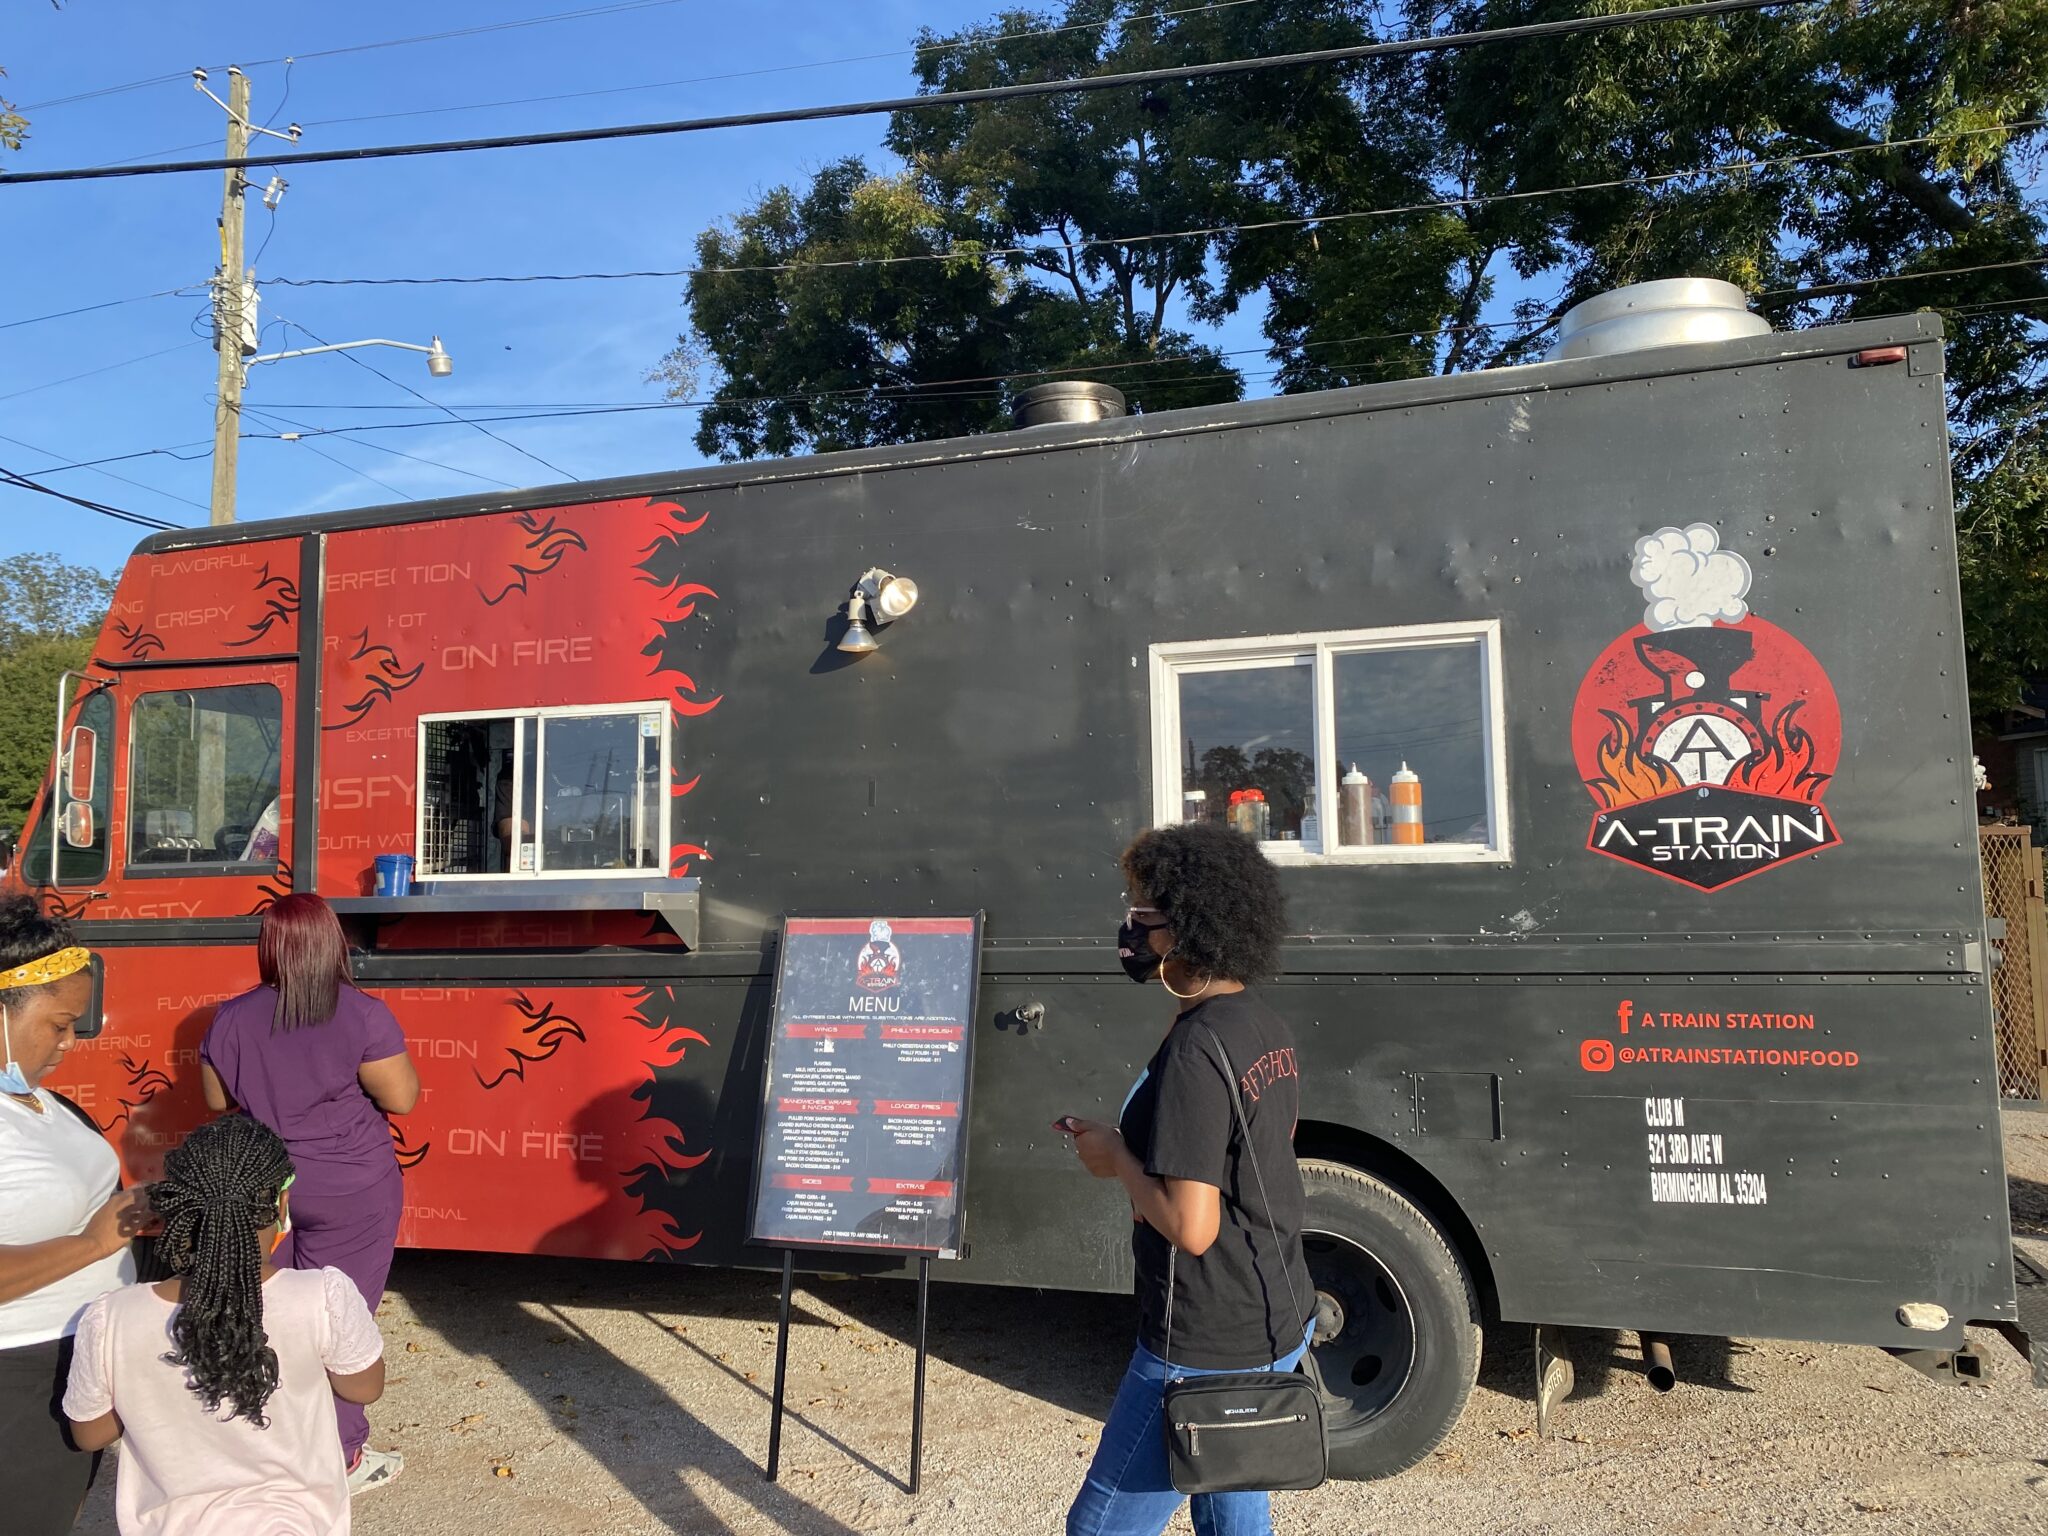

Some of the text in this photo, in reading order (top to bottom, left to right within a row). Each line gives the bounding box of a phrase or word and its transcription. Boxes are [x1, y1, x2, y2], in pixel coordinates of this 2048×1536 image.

[150, 552, 254, 577] FLAVORFUL
[155, 605, 235, 630] CRISPY
[441, 636, 593, 671] ON FIRE
[1598, 814, 1825, 848] A-TRAIN
[1652, 843, 1780, 861] STATION
[848, 996, 900, 1012] MENU
[1641, 1013, 1656, 1028] A
[1659, 1012, 1720, 1029] TRAIN
[1726, 1013, 1815, 1030] STATION
[403, 1038, 478, 1059] TION
[1618, 1047, 1860, 1068] @ATRAINSTATIONFOOD
[1645, 1097, 1685, 1127] CLUB M
[447, 1128, 604, 1162] ON FIRE
[1648, 1133, 1723, 1165] 521 3RD AVE W
[1650, 1172, 1768, 1205] BIRMINGHAM AL 35204
